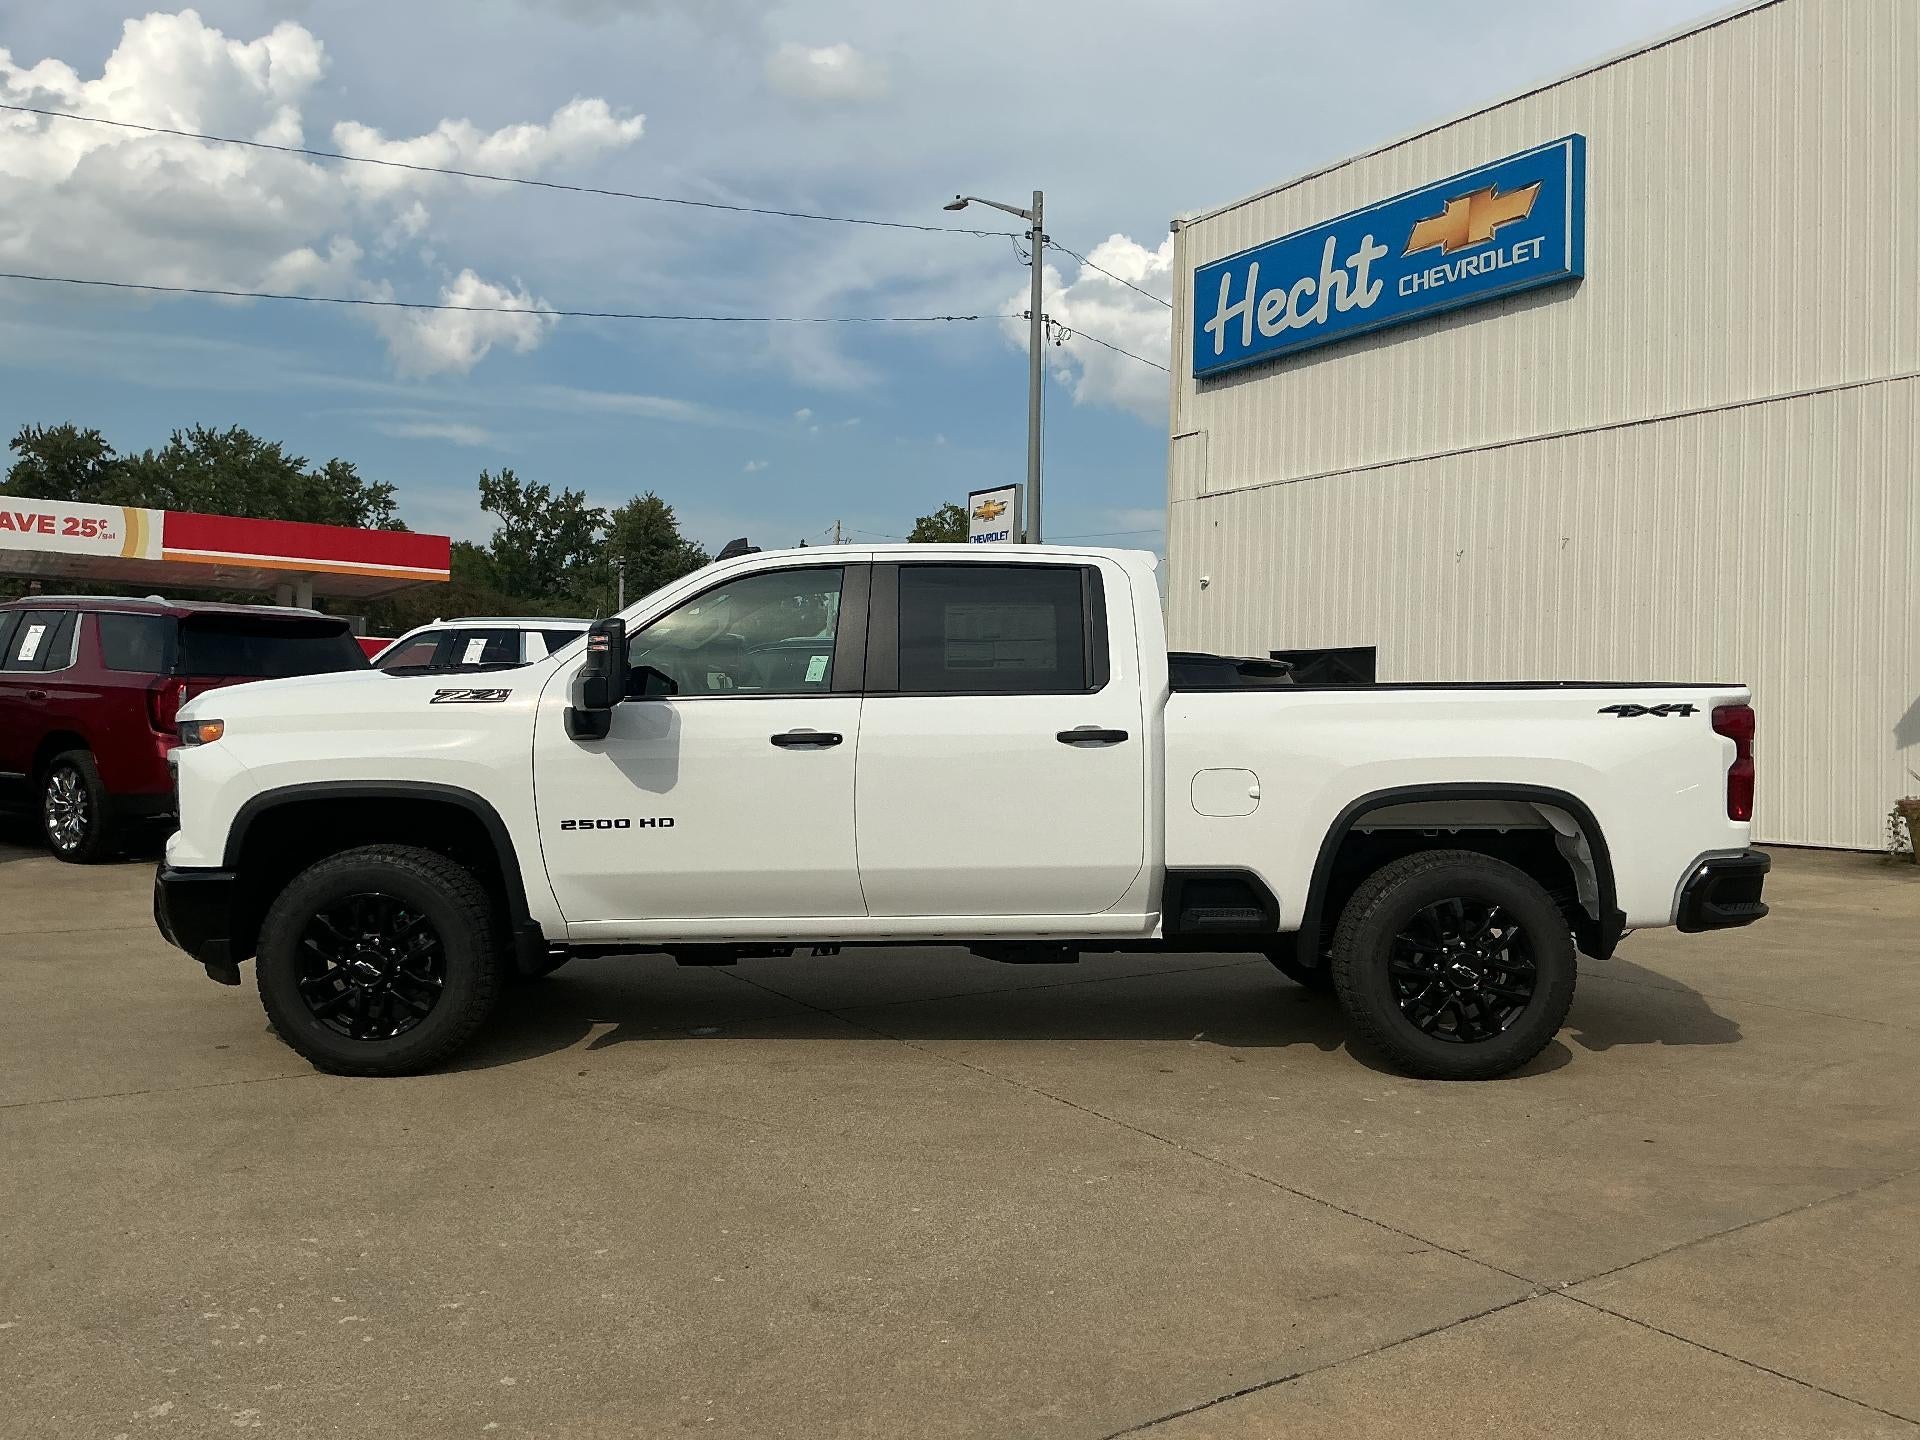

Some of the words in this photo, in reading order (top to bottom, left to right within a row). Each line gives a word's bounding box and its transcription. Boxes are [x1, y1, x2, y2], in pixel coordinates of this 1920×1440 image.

[1204, 234, 1388, 355] Hecht
[1399, 236, 1545, 296] CHEVROLET
[970, 530, 1009, 544] CHEVROLET
[560, 818, 631, 830] 2500
[639, 817, 675, 828] HD
